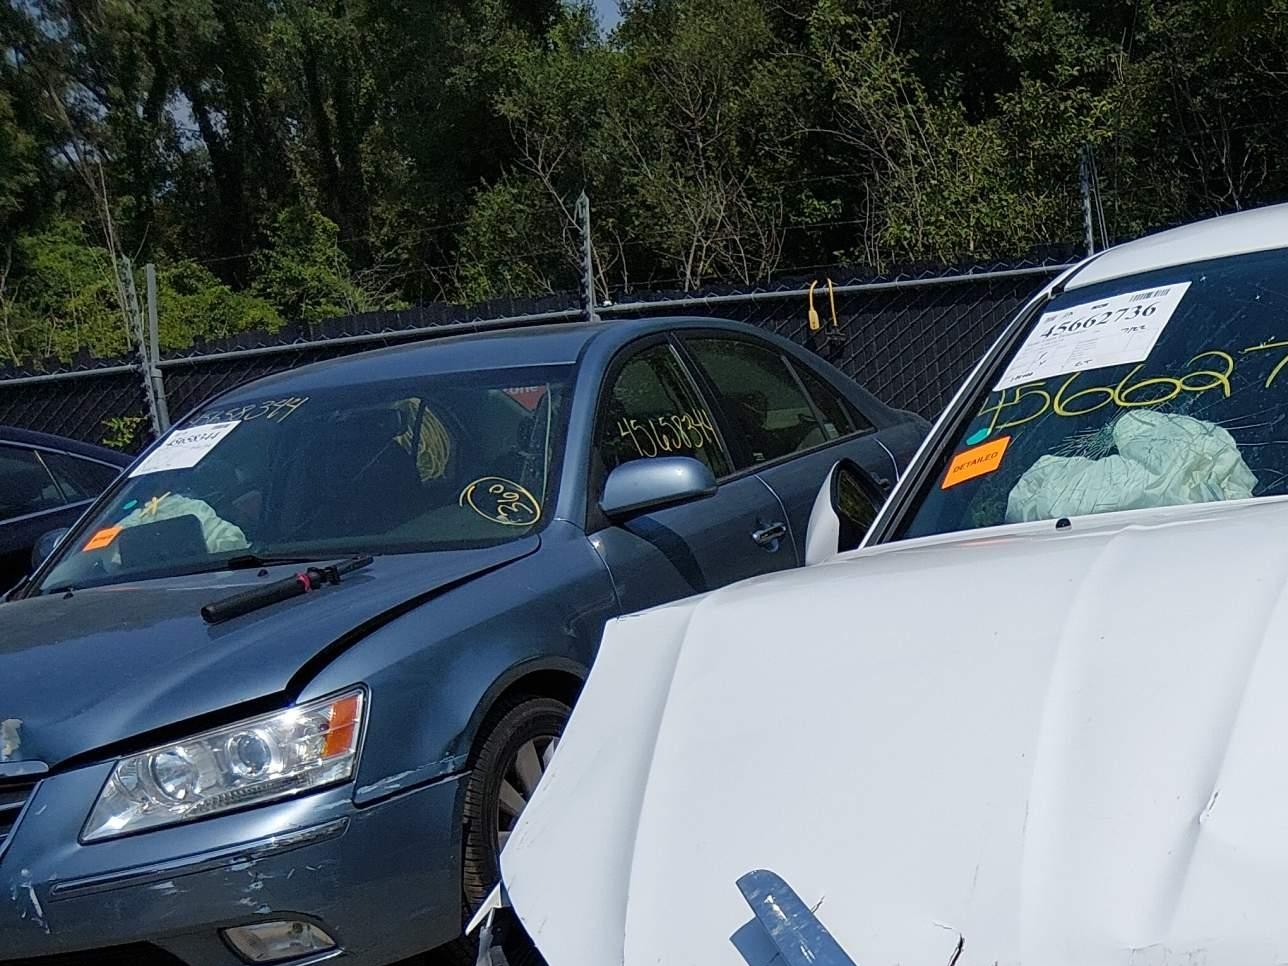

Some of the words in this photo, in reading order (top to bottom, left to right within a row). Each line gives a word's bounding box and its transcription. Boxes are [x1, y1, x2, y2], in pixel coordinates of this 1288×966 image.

[1041, 302, 1161, 338] 45662736
[617, 408, 724, 458] 45658344
[953, 451, 999, 473] DETAILED
